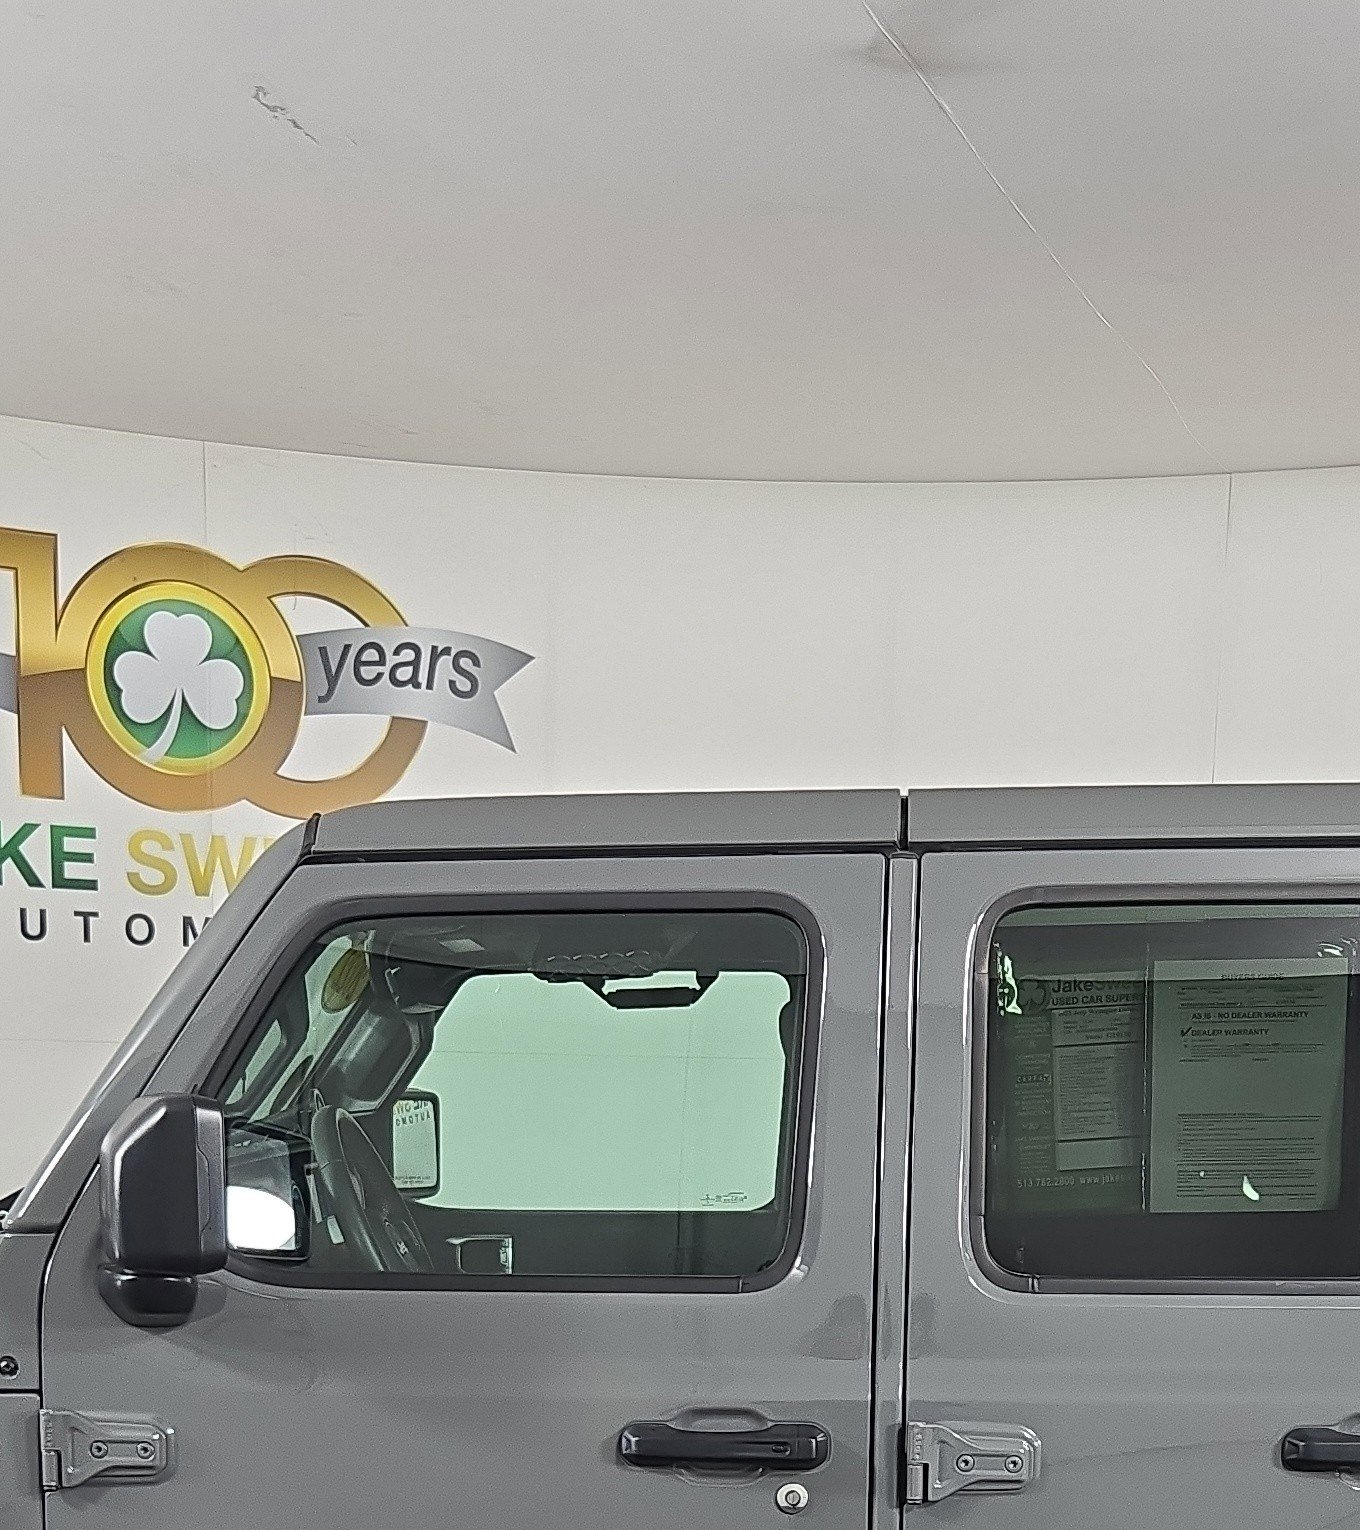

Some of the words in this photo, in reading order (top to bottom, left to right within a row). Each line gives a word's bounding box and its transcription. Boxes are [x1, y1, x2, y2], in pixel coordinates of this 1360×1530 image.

[317, 641, 483, 703] years
[126, 828, 276, 896] SW
[1231, 1011, 1263, 1019] DEALER
[1263, 1010, 1309, 1018] WARRANTY
